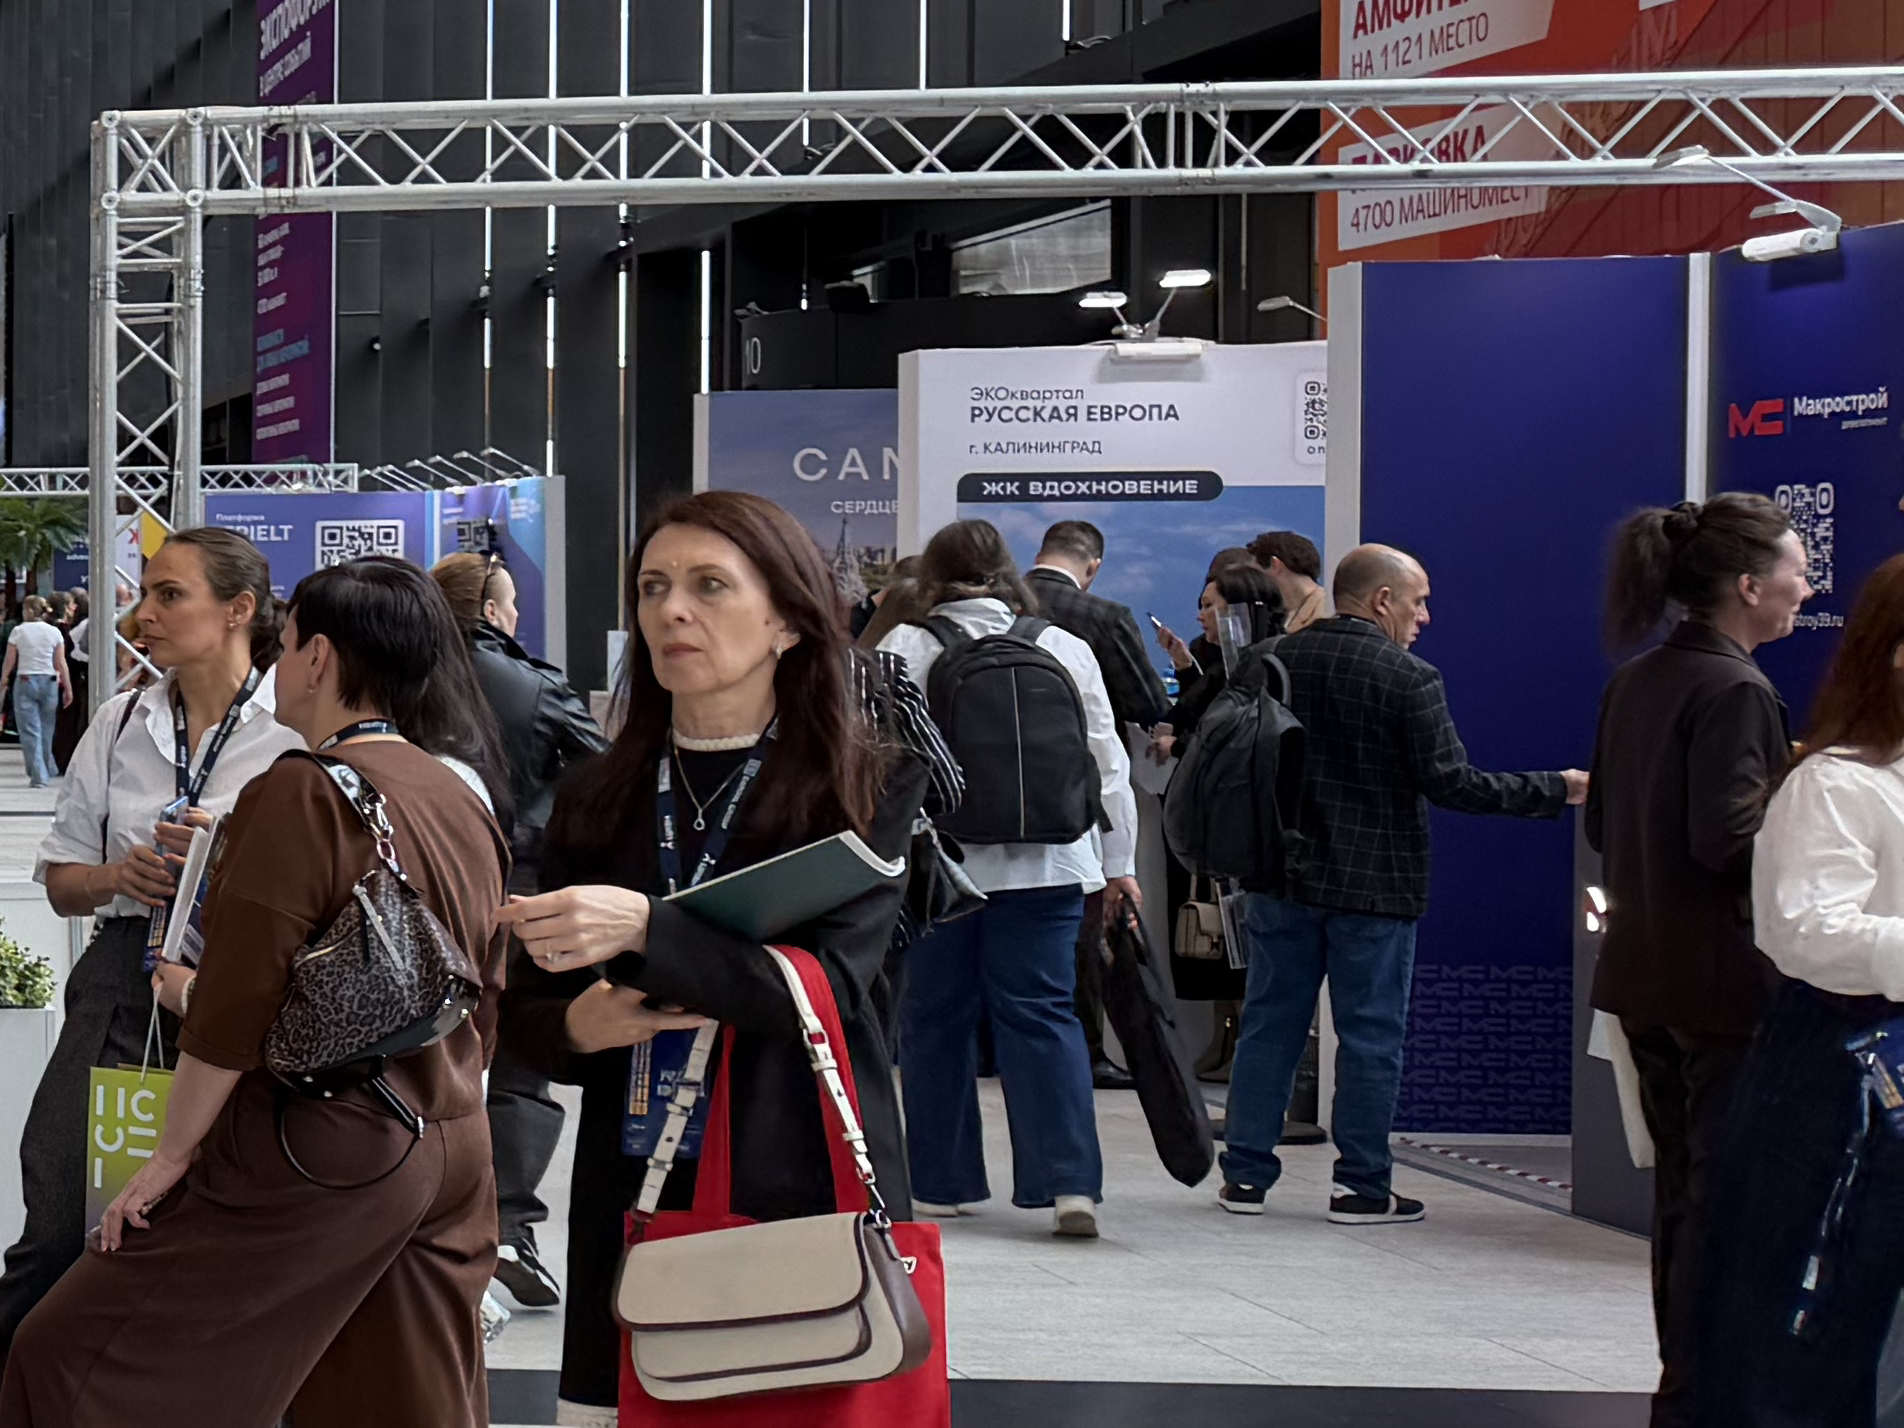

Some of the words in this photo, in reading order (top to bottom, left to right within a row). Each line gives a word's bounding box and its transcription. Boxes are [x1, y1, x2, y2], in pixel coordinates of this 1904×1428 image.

[1351, 48, 1375, 79] НА
[1381, 35, 1424, 71] 1121
[1430, 12, 1489, 57] МЕСТО
[1350, 199, 1394, 233] 4700
[970, 386, 1085, 403] ЭКОквартал
[1793, 386, 1889, 419] Макрострой
[970, 405, 1080, 424] РУССКАЯ
[1086, 404, 1180, 422] ЕВРОПА
[969, 445, 979, 454] г.
[983, 440, 1103, 456] КАЛИНИНГРАД
[983, 481, 1020, 496] ЖК
[1028, 479, 1199, 496] ВДОХНОВЕНИЕ
